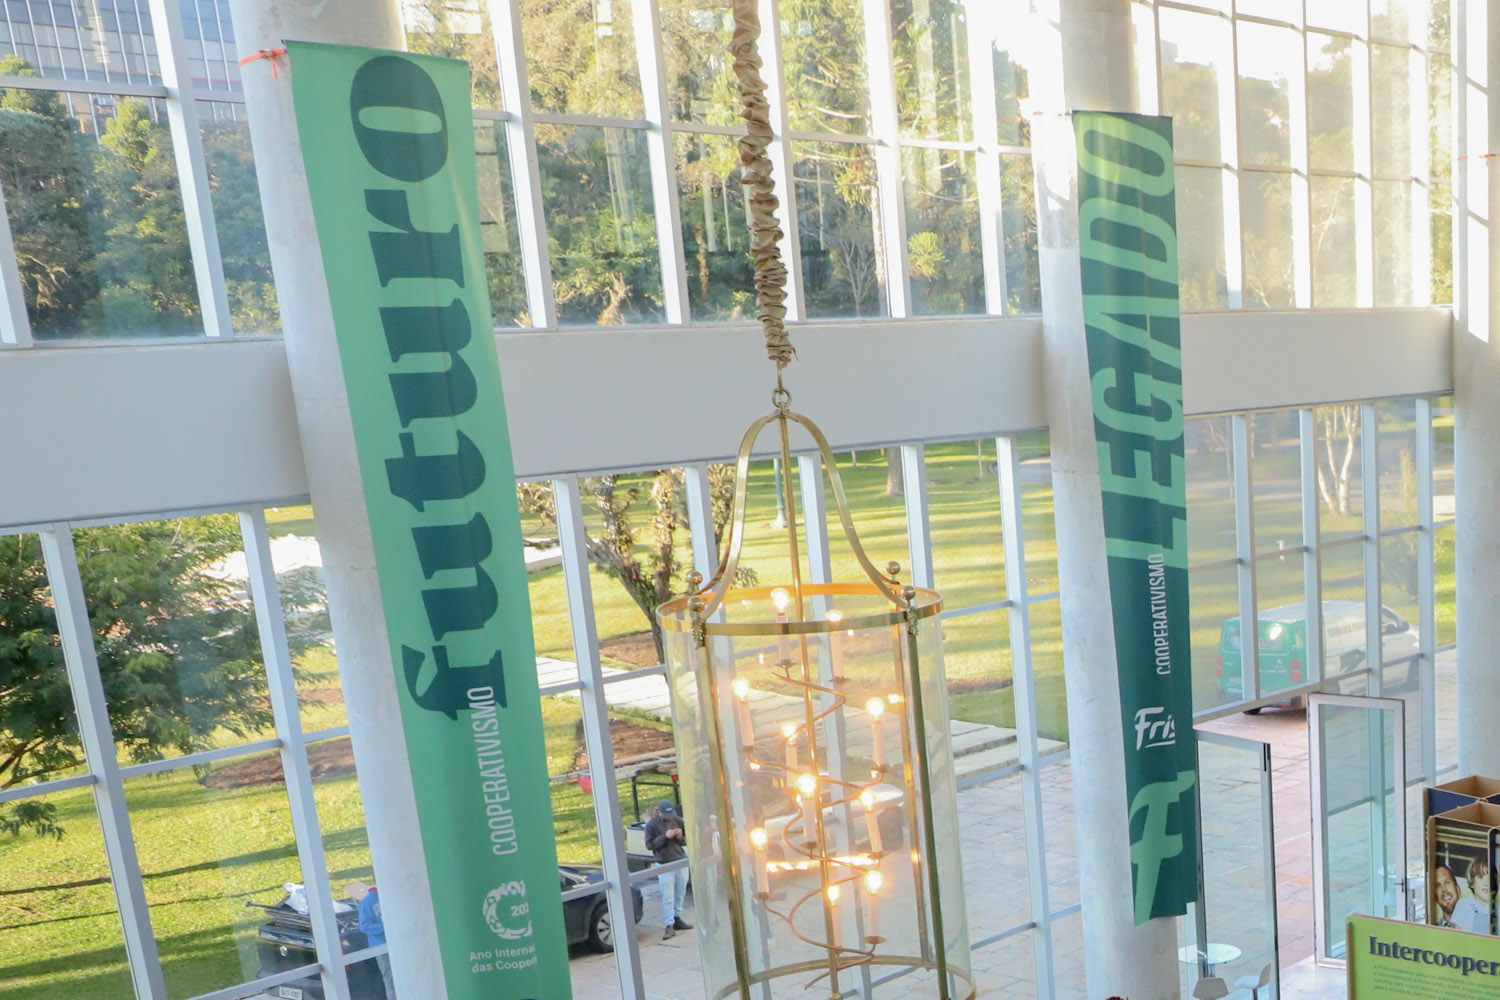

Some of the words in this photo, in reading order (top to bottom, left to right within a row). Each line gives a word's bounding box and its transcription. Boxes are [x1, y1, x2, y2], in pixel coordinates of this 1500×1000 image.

[350, 55, 507, 721] futuro
[1074, 112, 1188, 569] LEGADO
[1148, 553, 1171, 676] COOPERATIVISMO
[467, 685, 519, 855] COOPERATIVISMO
[469, 950, 492, 961] Ano
[472, 962, 493, 973] das
